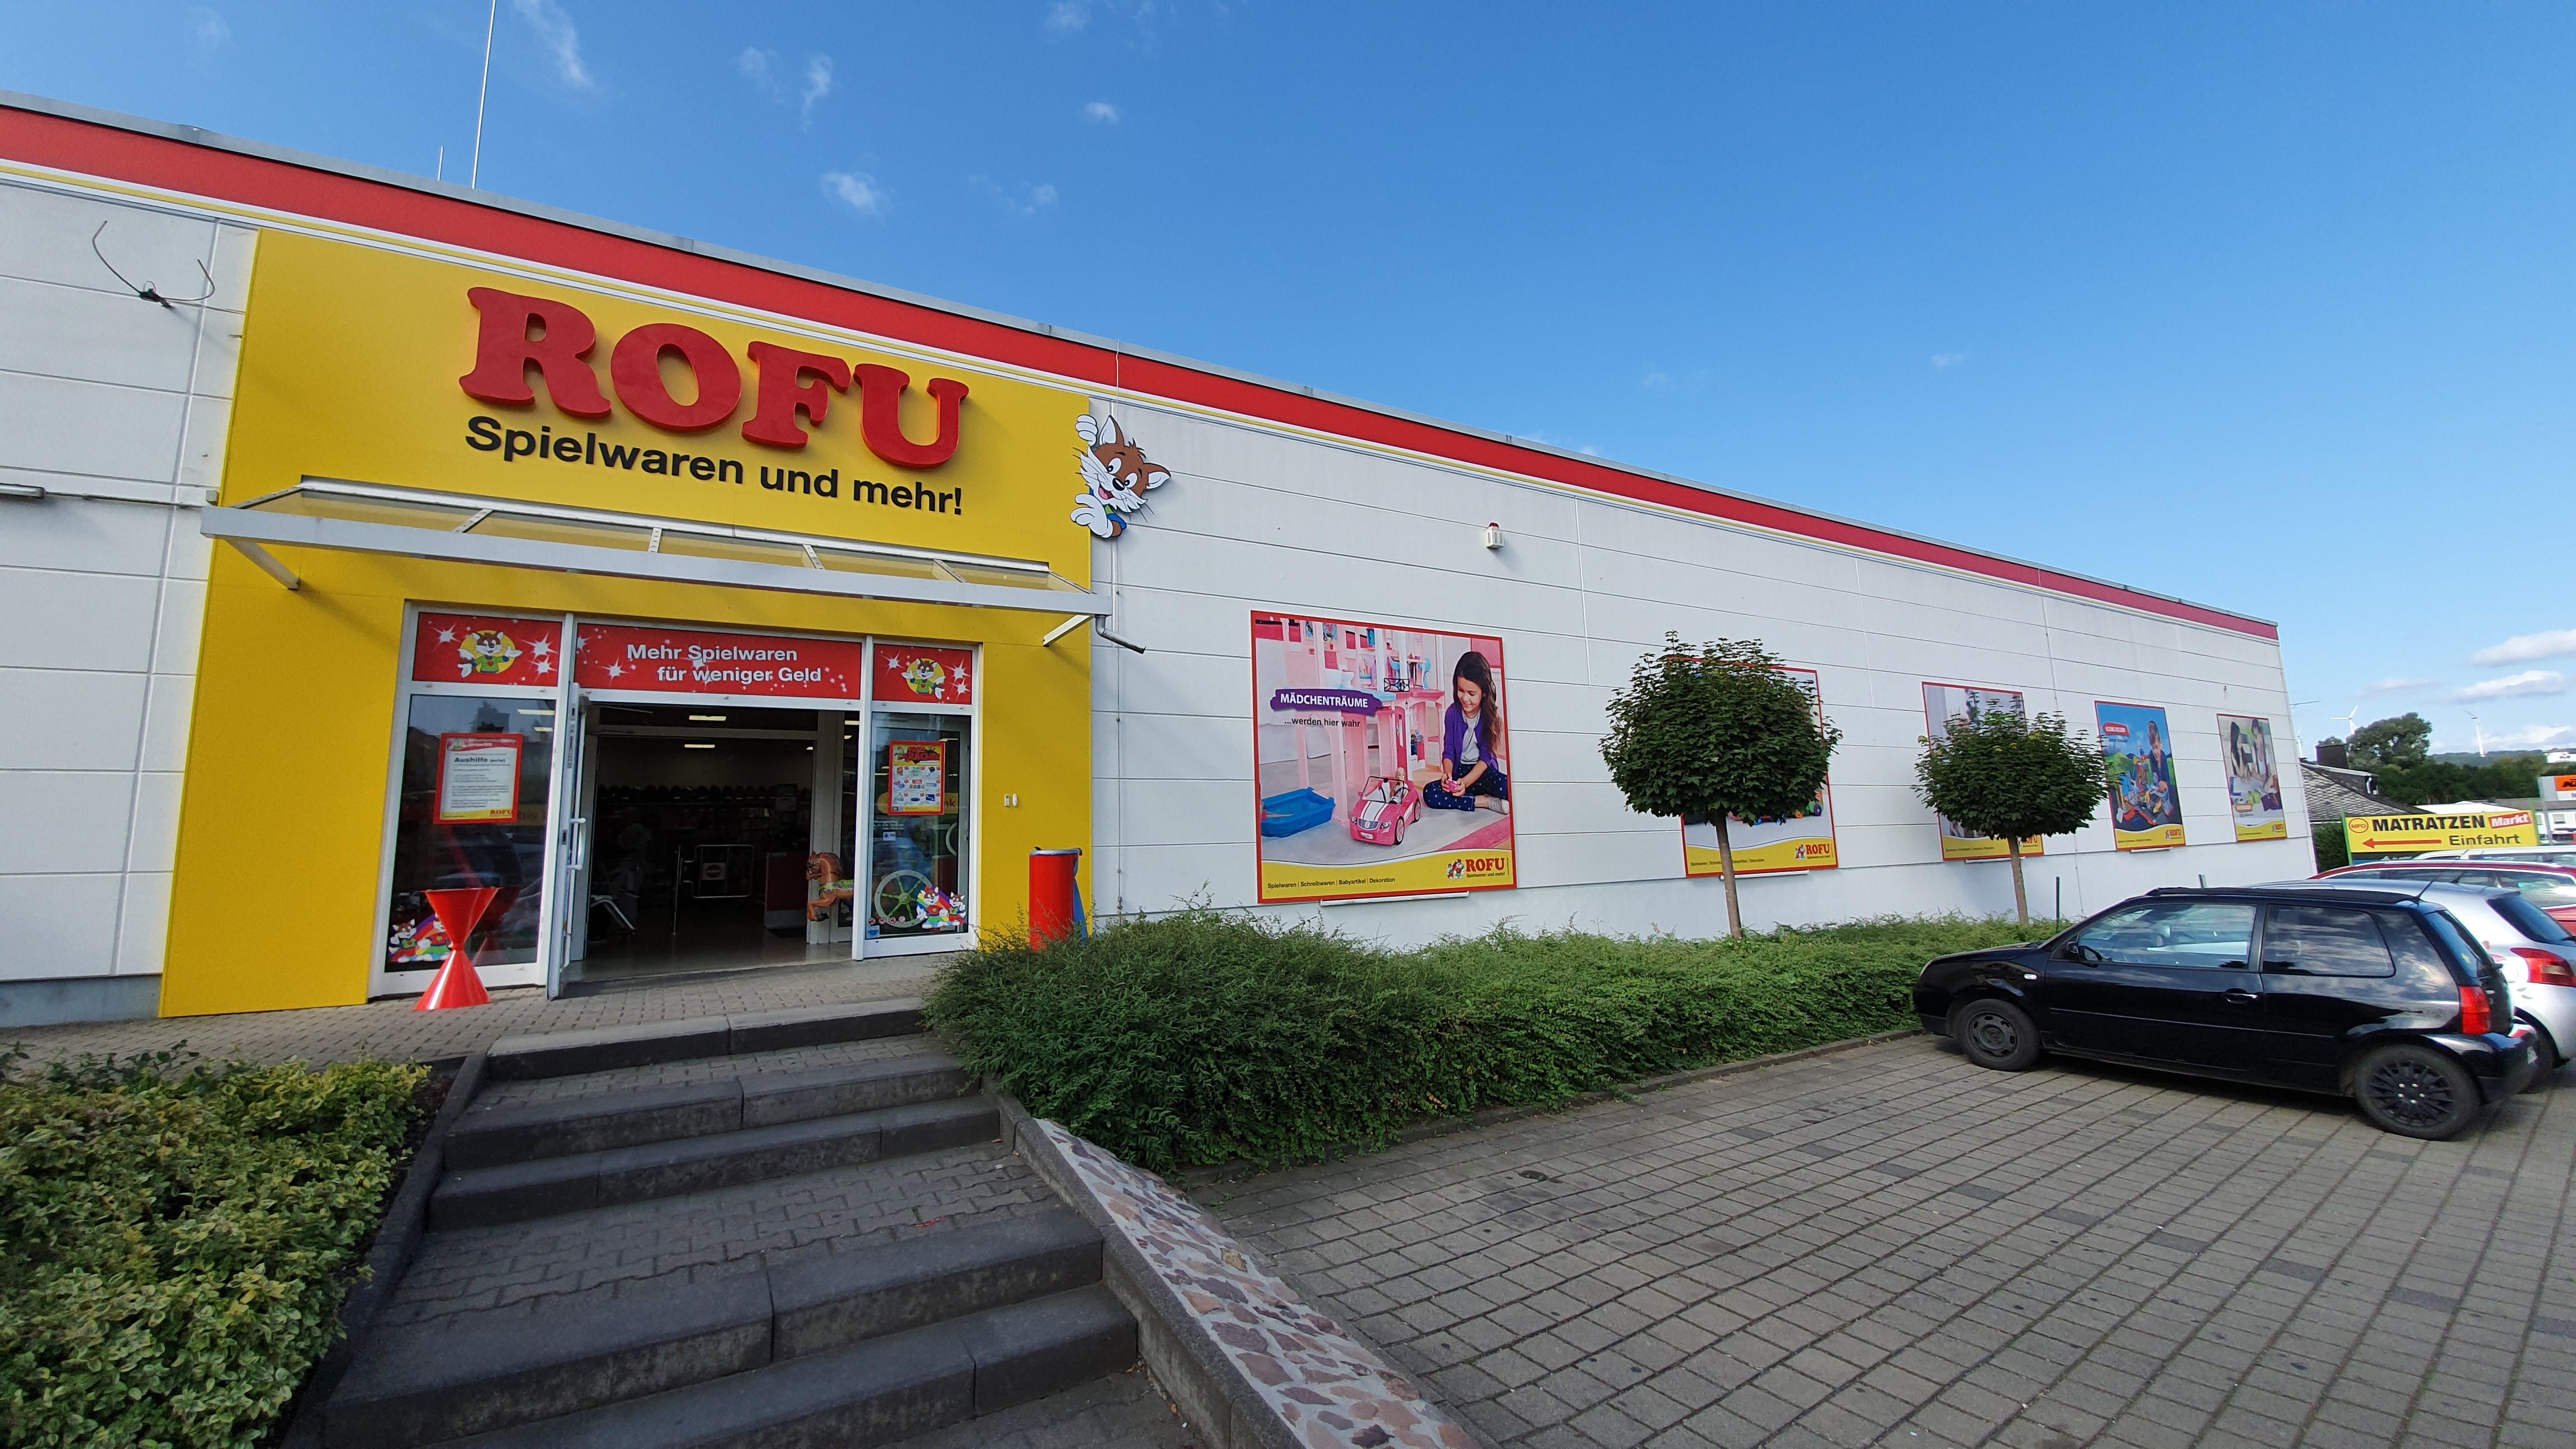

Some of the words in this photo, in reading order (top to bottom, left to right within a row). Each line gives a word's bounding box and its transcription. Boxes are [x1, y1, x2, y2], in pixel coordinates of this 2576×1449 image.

[458, 286, 969, 470] ROFU
[465, 416, 744, 485] Spielwaren
[760, 466, 839, 499] und
[853, 479, 962, 515] mehr!
[627, 644, 683, 660] Mehr
[688, 645, 798, 664] Spielwaren
[657, 666, 687, 681] für
[692, 667, 774, 685] weniger
[778, 667, 822, 682] Geld
[1280, 693, 1368, 708] MÄDCHENTRÄUME
[1324, 718, 1339, 727] hier
[2372, 815, 2485, 832] MATRATZEN
[2491, 813, 2529, 828] Markt
[2449, 834, 2521, 846] Einfahrt
[1805, 844, 1830, 855] ROFU
[1465, 858, 1505, 872] ROFU
